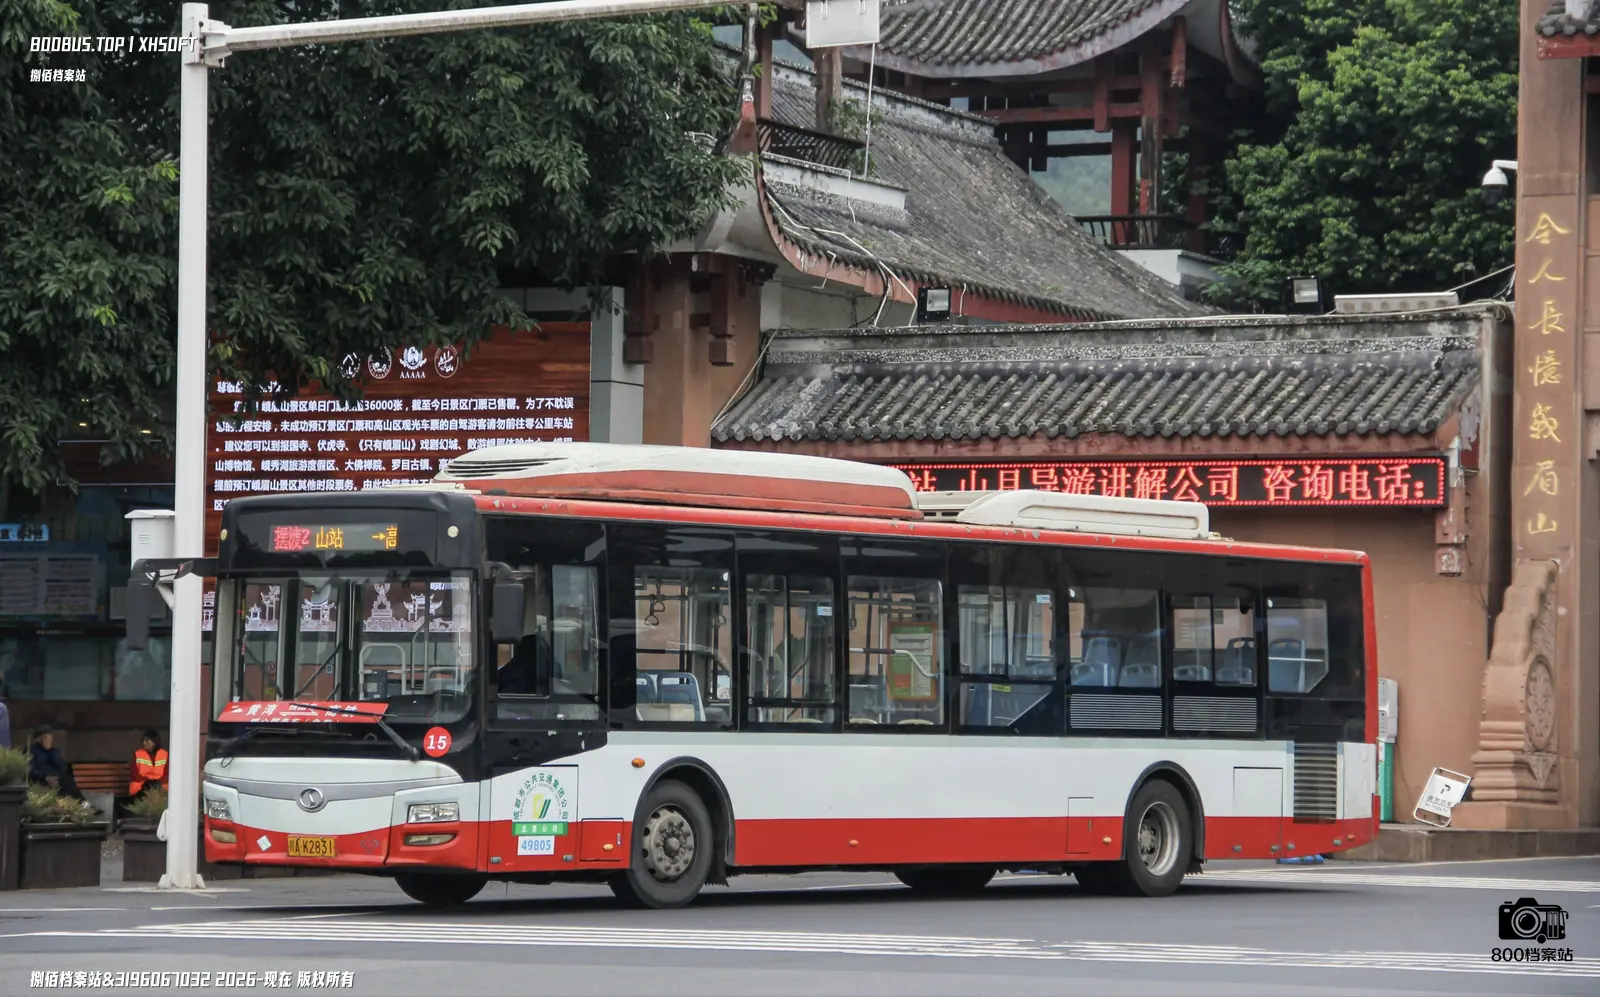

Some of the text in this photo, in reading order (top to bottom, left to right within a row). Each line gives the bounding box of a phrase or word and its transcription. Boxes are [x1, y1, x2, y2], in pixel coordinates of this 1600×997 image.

[213, 499, 229, 511] 区
[315, 526, 343, 549] 山站
[426, 734, 447, 750] 15
[521, 839, 551, 851] 49805
